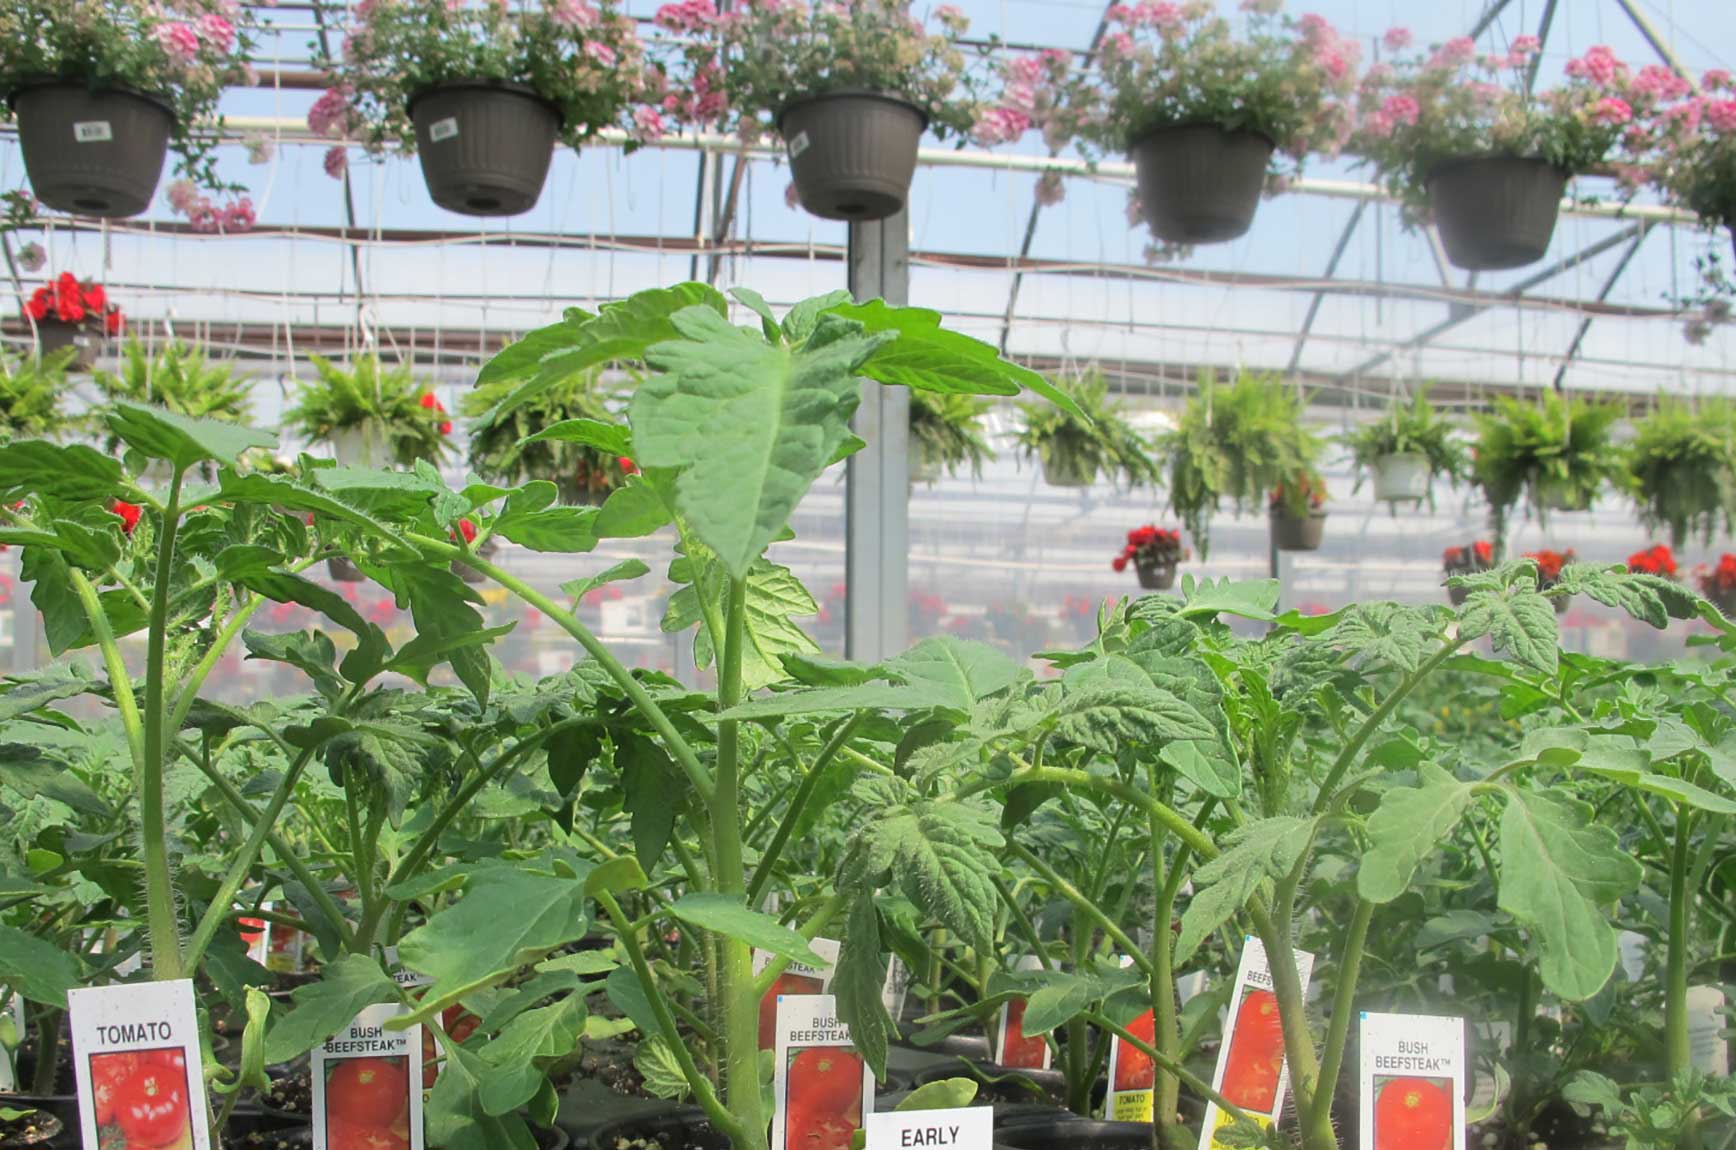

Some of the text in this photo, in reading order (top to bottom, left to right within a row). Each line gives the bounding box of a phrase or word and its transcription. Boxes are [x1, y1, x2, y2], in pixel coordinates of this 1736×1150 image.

[96, 1021, 172, 1045] TOMATO
[350, 1026, 383, 1039] BUSH
[1398, 1040, 1429, 1055] BUSH
[901, 1126, 960, 1147] EARLY
